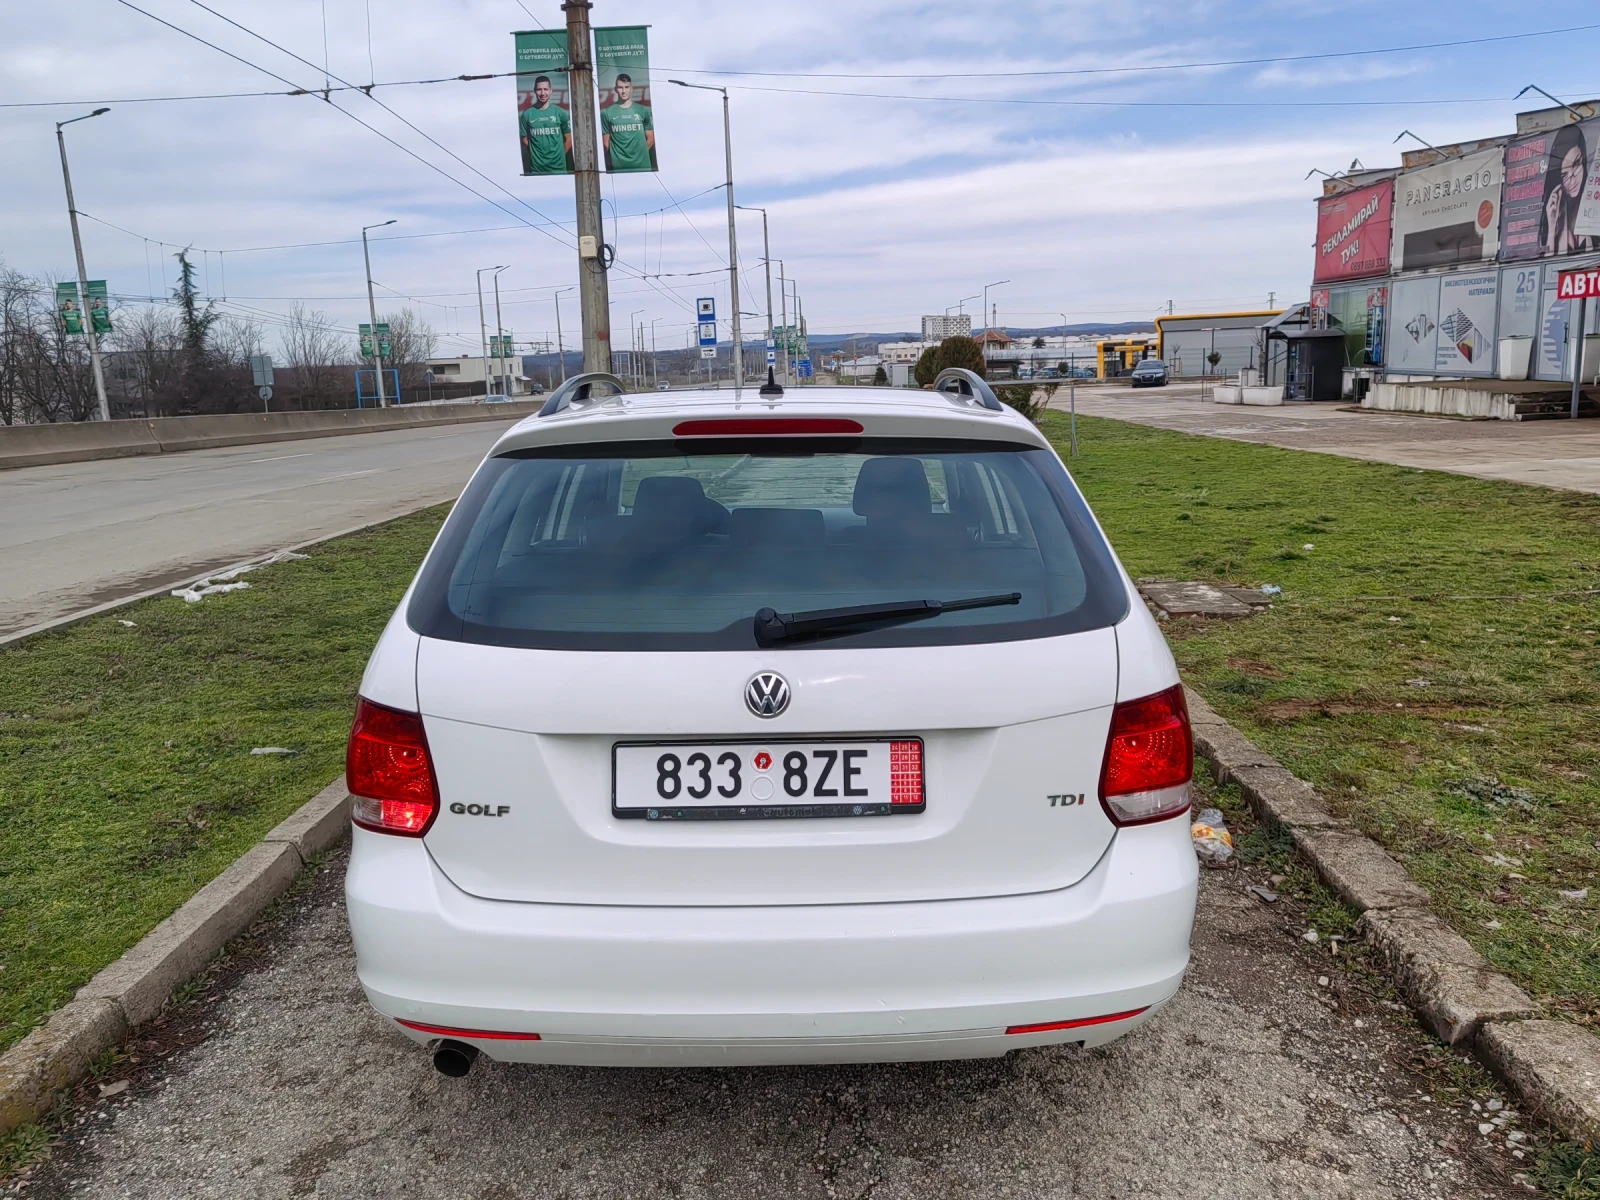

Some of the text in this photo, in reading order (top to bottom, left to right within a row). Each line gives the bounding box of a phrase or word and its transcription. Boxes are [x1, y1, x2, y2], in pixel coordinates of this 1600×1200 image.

[530, 126, 560, 136] WINBET
[611, 123, 643, 133] WINBET
[1540, 160, 1548, 174] &
[1406, 170, 1491, 206] PANCRACIO
[1441, 201, 1468, 212] CHOCOLATE
[1322, 194, 1379, 257] РЕКЛАМИРАЙ
[1340, 239, 1359, 264] ТУК!
[1516, 271, 1536, 294] 25
[1560, 272, 1600, 297] АВТ
[1468, 287, 1495, 296] МАТЕРИАЛИ
[656, 749, 868, 800] 833 8ZE
[1046, 793, 1085, 807] TDI
[449, 802, 511, 817] GOLF
